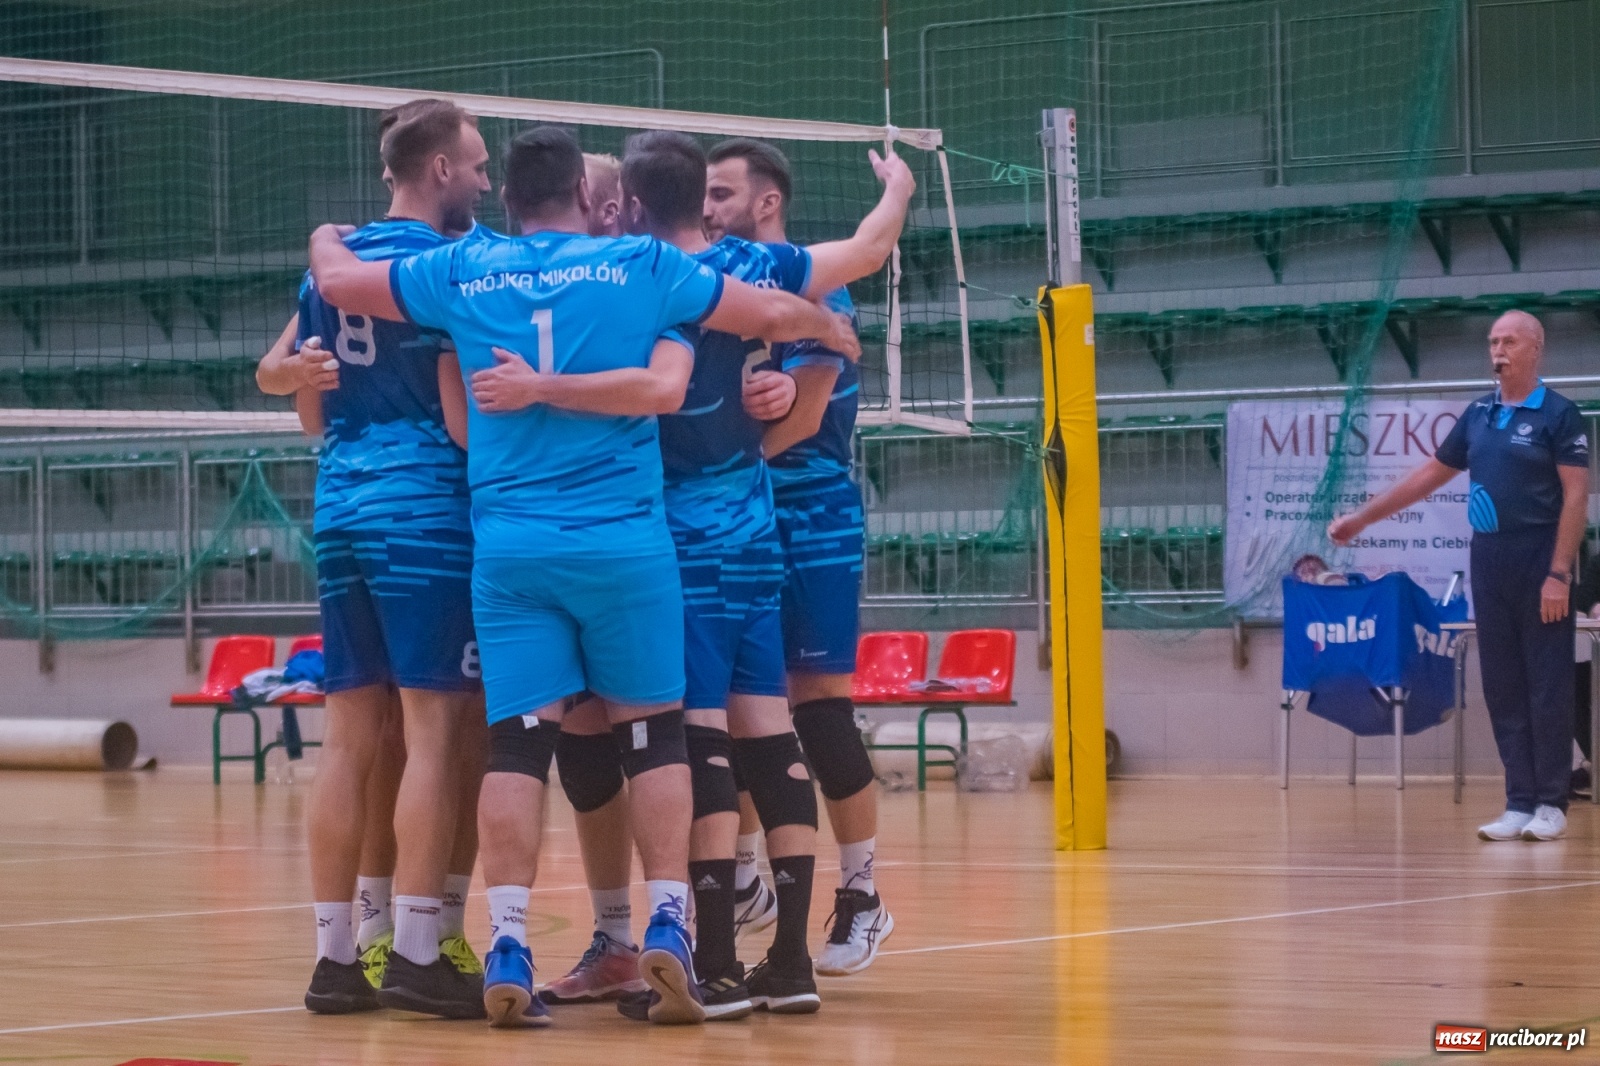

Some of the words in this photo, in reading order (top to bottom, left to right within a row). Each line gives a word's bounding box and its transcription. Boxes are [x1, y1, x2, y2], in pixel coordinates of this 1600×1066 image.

[538, 261, 629, 288] MIKOŁÓW
[336, 307, 377, 367] 8
[530, 308, 555, 377] 1
[1330, 491, 1375, 505] urządz
[1348, 536, 1408, 551] zekamy
[1412, 539, 1427, 549] na
[1431, 536, 1472, 549] Ciebi
[1306, 615, 1376, 652] gala
